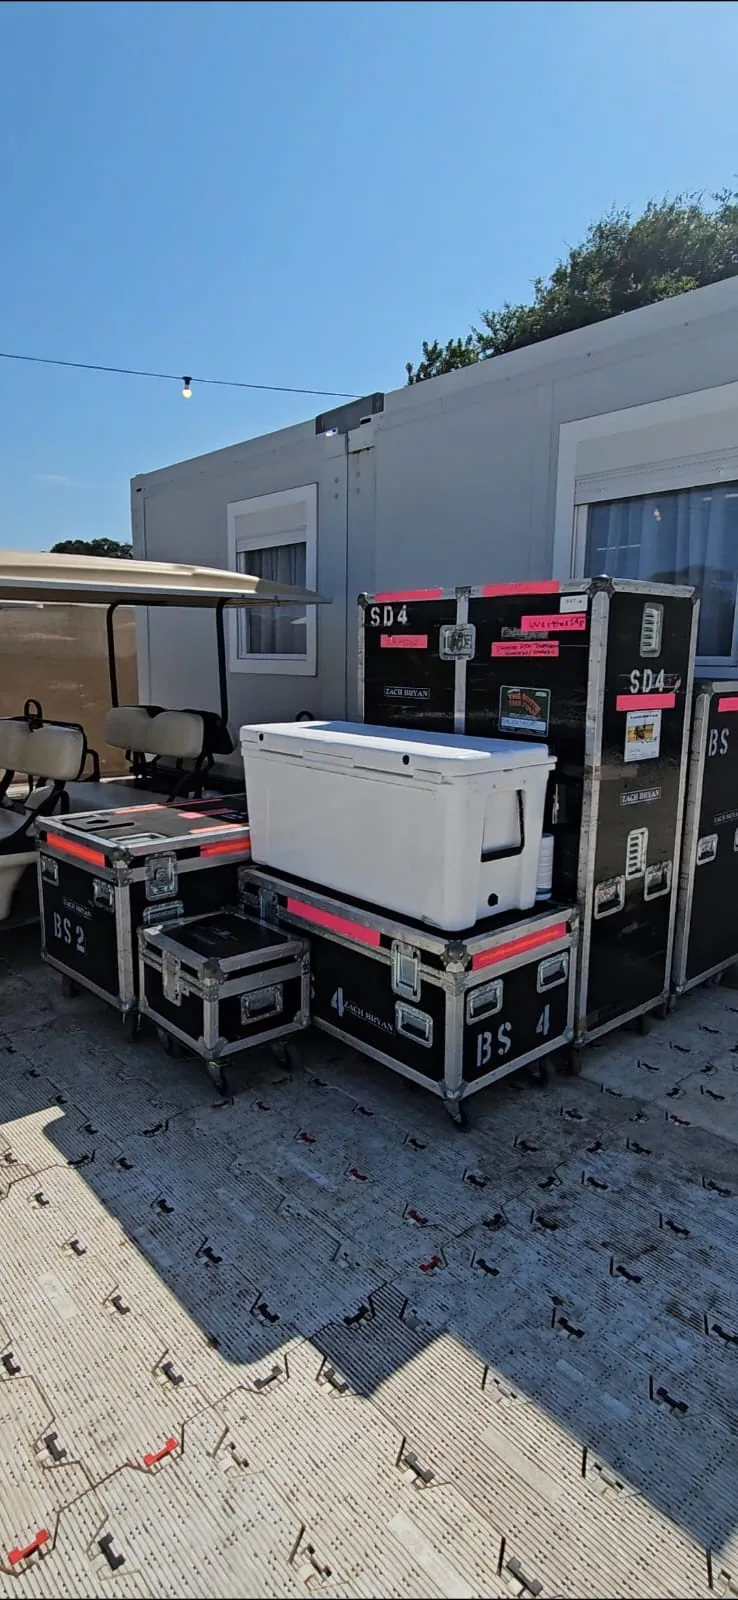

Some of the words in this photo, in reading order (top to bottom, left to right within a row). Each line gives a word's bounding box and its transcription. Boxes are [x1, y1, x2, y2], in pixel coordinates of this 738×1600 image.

[370, 604, 408, 627] SD4
[385, 688, 403, 696] ZACH
[404, 689, 428, 697] BRYAN
[630, 669, 665, 694] SD4
[709, 728, 729, 757] BS
[622, 792, 639, 803] ZACH
[639, 789, 660, 800] BRYAN
[331, 987, 344, 1017] 4
[343, 1000, 364, 1017] ZACH
[365, 1012, 394, 1032] BRYAN
[476, 1021, 512, 1067] BS
[536, 1004, 550, 1036] 4
